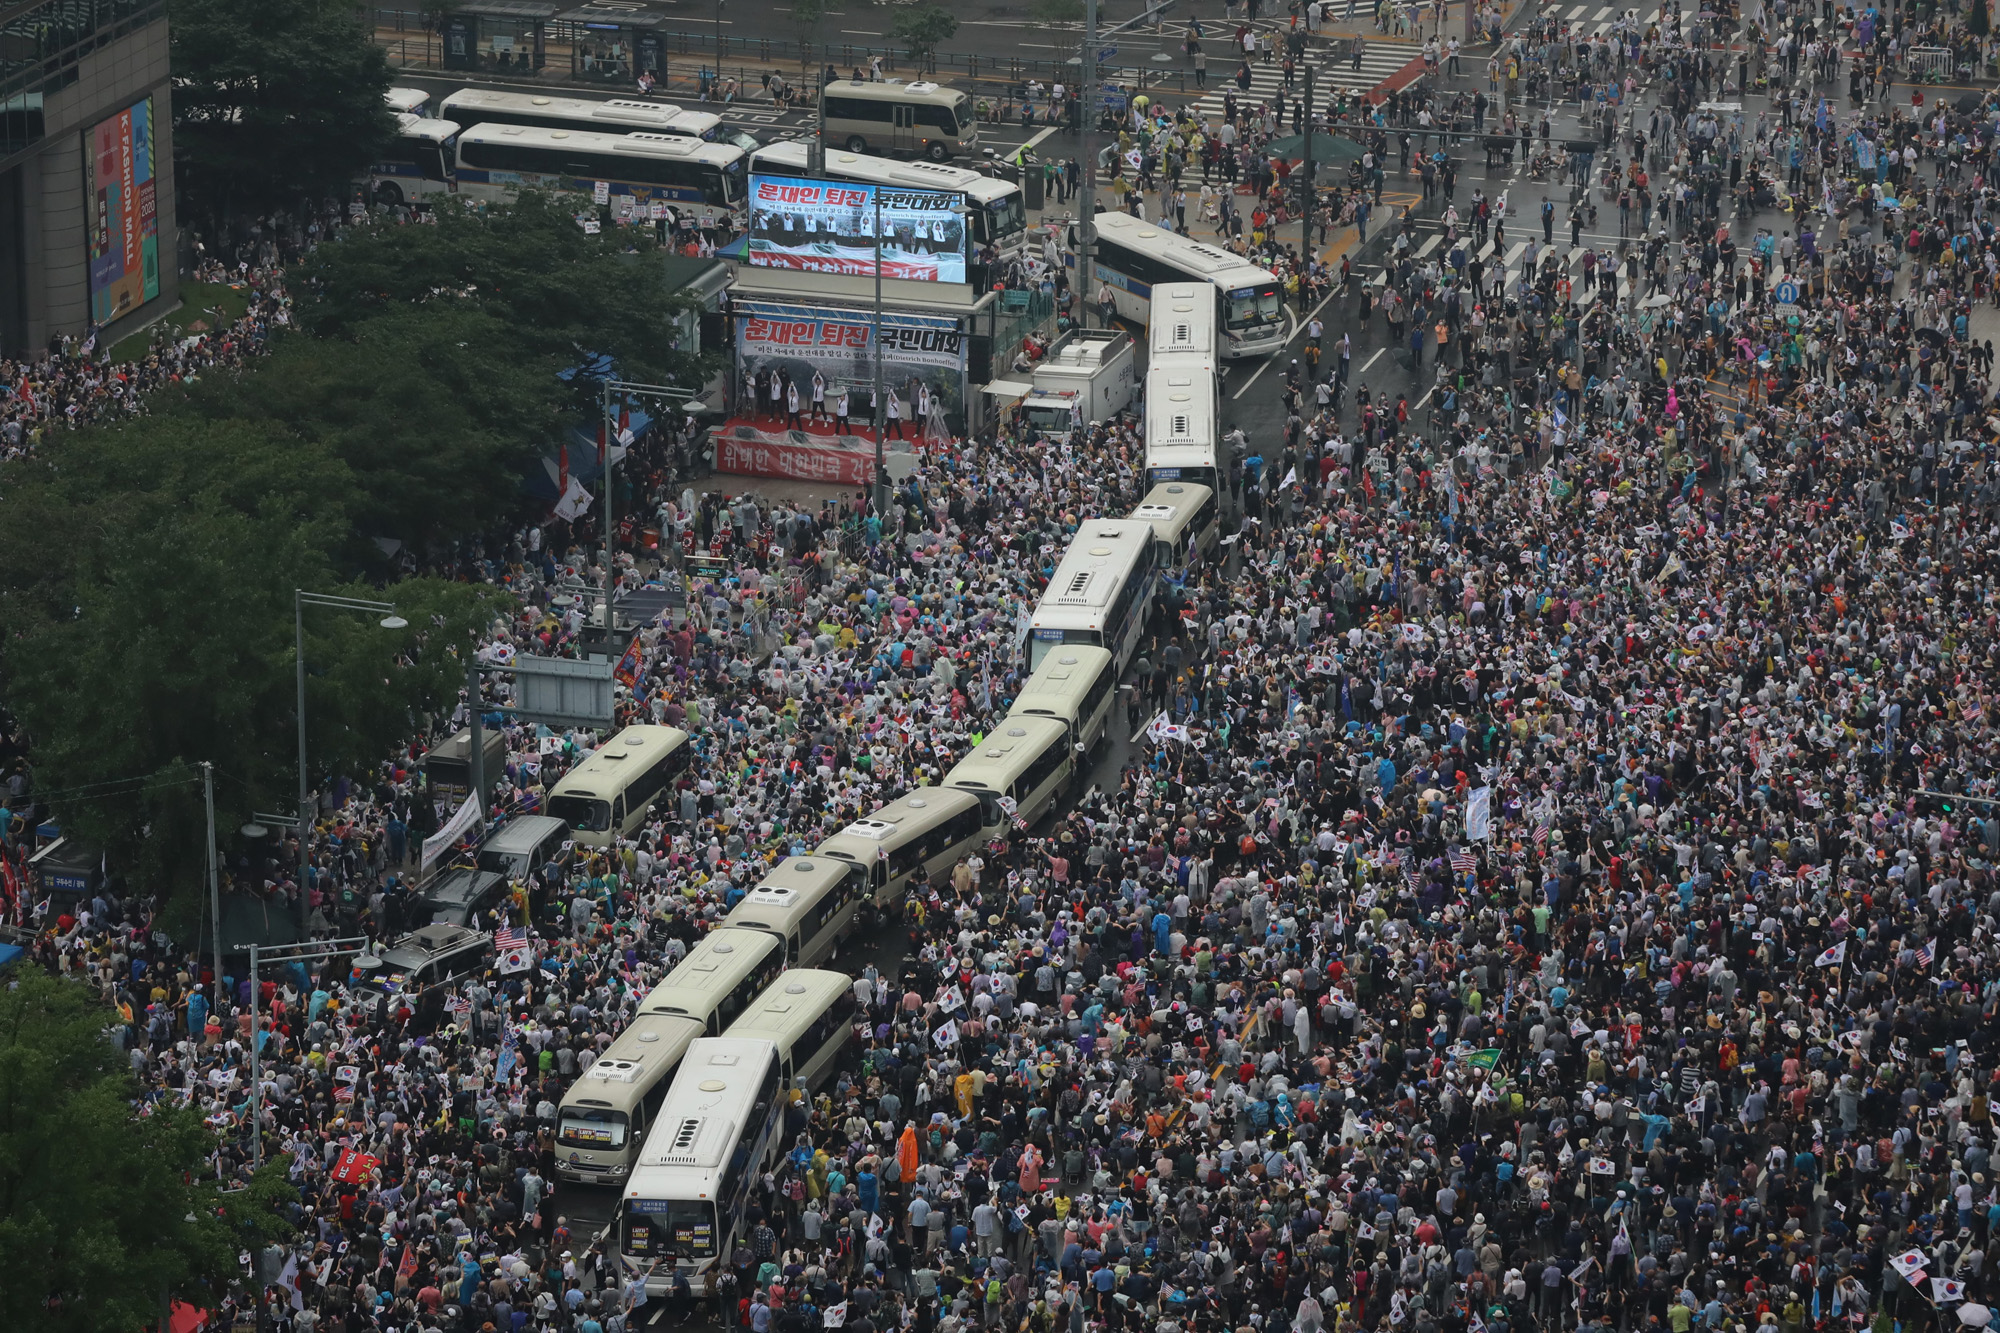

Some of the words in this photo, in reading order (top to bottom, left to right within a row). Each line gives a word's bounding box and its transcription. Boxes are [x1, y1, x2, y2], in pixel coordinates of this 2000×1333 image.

[121, 113, 132, 214] K-FASHION
[141, 200, 156, 217] 2020
[662, 189, 679, 199] 경찰
[757, 183, 818, 206] 문재인
[824, 187, 868, 208] 퇴진
[125, 215, 135, 266] MALL
[745, 317, 815, 345] 문재인
[819, 321, 870, 348] 퇴진
[874, 328, 962, 355] 국민대회
[724, 444, 769, 473] 위대한
[779, 451, 841, 480] 대한민국
[338, 1152, 357, 1179] 경남
